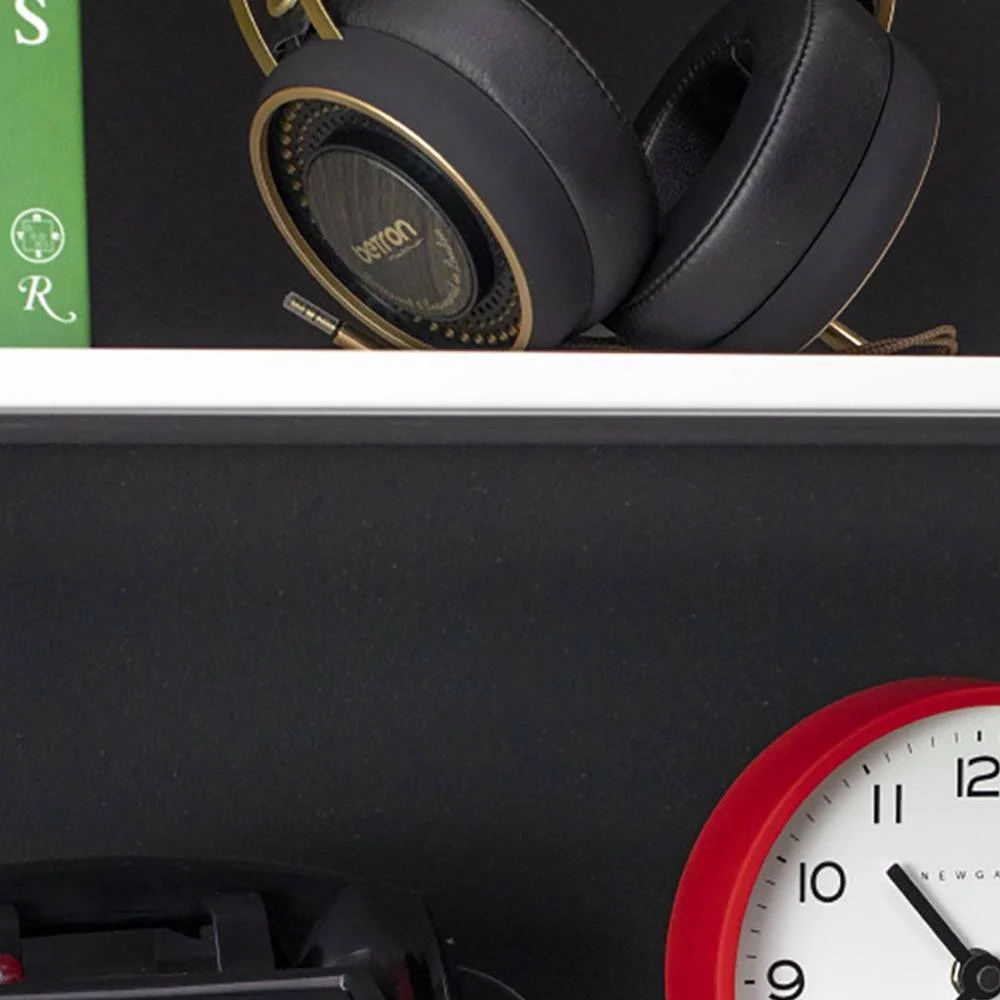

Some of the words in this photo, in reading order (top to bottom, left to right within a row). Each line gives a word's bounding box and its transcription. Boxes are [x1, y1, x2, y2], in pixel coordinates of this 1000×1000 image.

[956, 755, 1000, 798] 12
[873, 784, 903, 825] 11
[799, 861, 847, 904] 10
